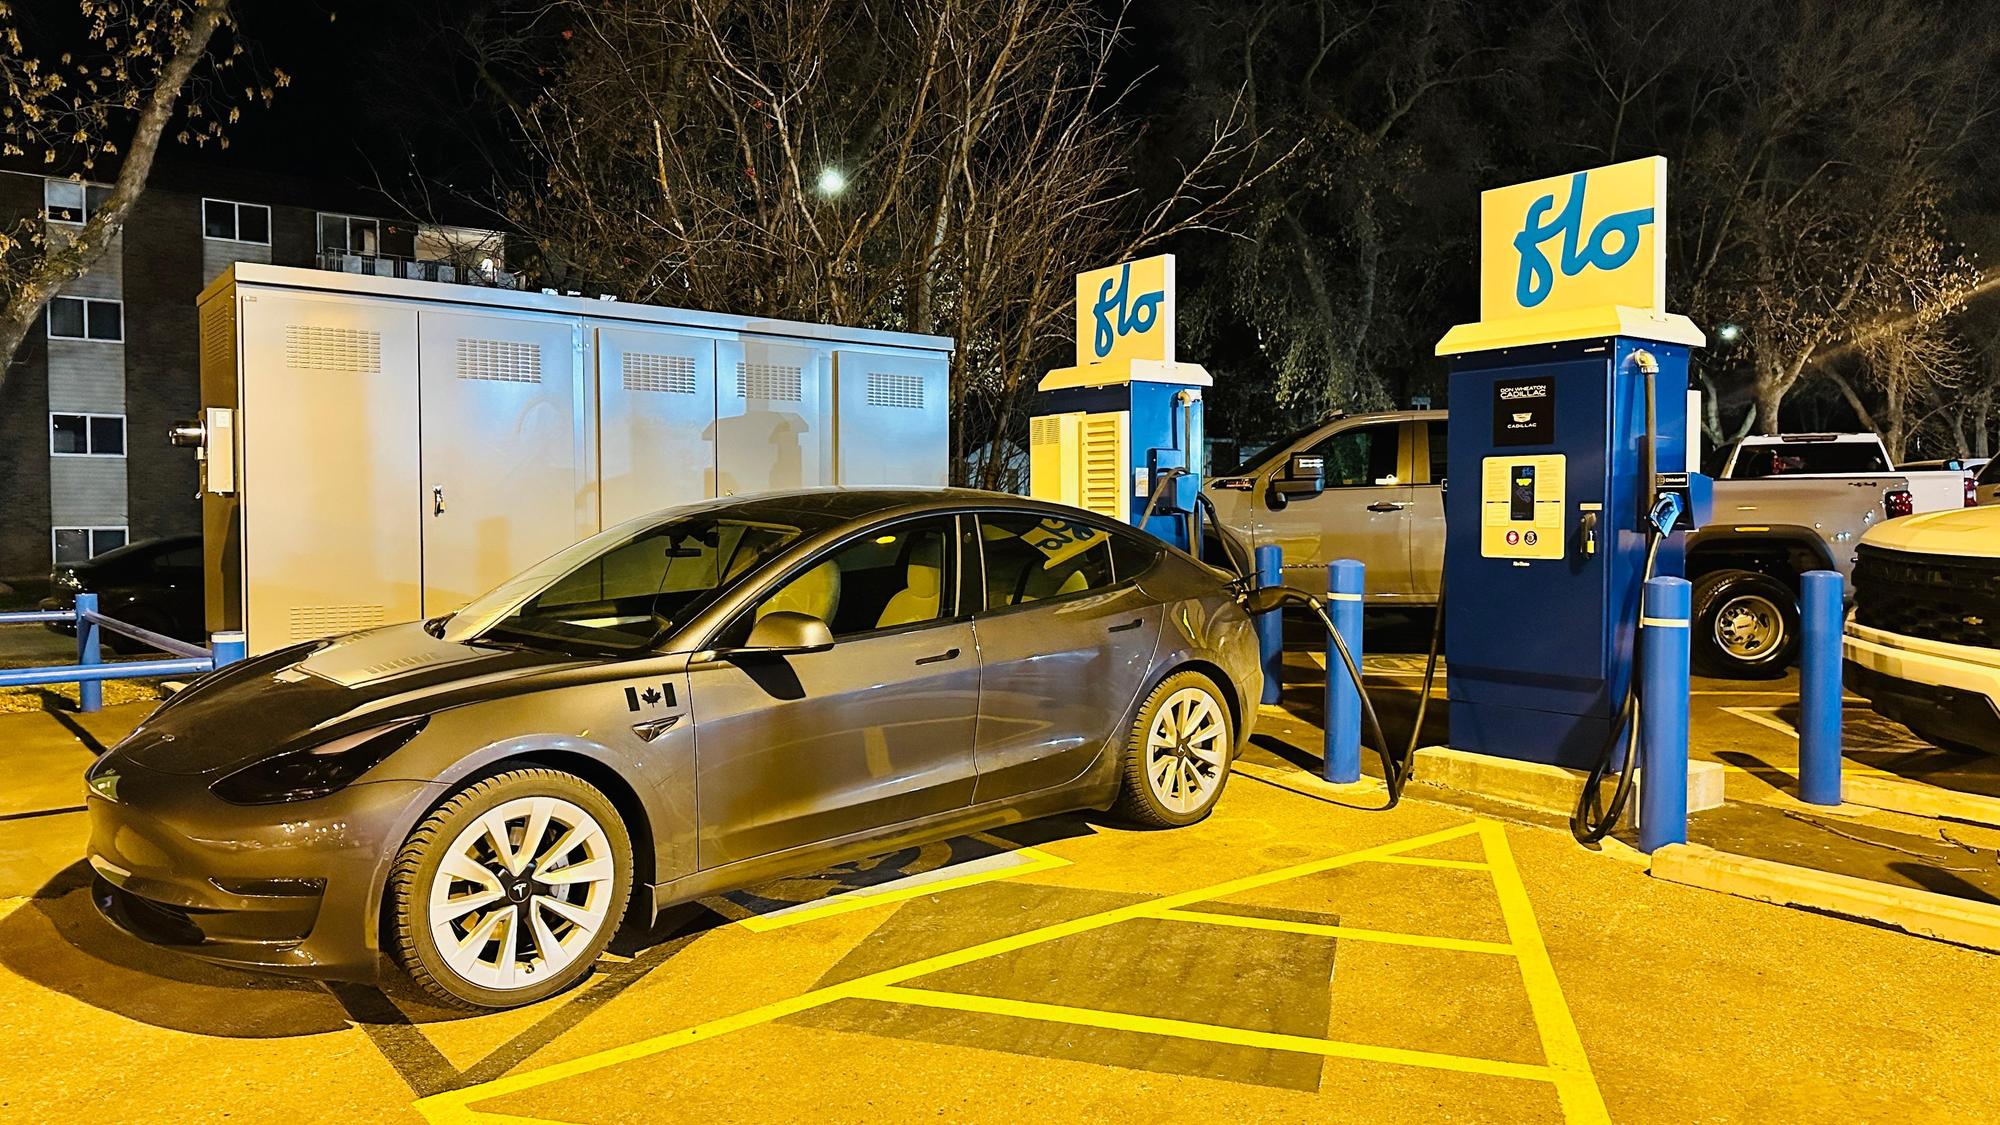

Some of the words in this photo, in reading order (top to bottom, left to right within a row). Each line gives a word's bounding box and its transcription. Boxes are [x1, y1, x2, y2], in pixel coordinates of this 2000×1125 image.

[1513, 172, 1654, 307] flo
[1093, 263, 1164, 357] flo
[1500, 389, 1547, 398] CADILLAC
